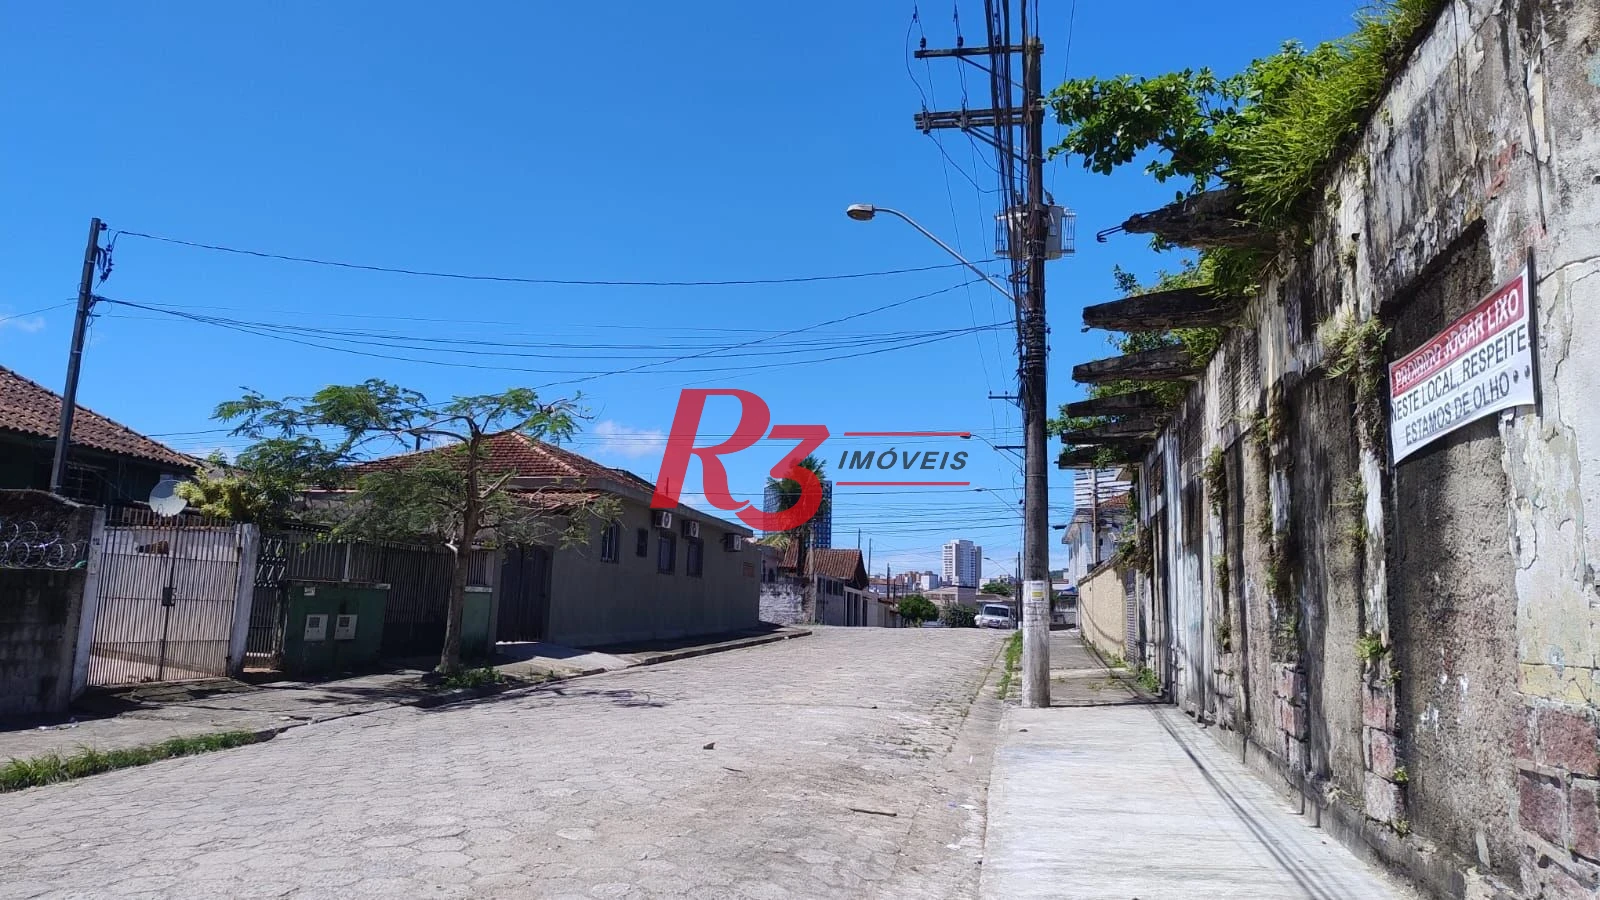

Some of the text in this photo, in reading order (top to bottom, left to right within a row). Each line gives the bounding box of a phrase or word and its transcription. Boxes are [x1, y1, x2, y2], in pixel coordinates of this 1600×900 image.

[1443, 314, 1484, 358] JOGAR
[1487, 288, 1518, 329] LIXO
[1406, 371, 1511, 445] ESTAMOS DE OLHO
[1422, 367, 1460, 406] LOCAL,
